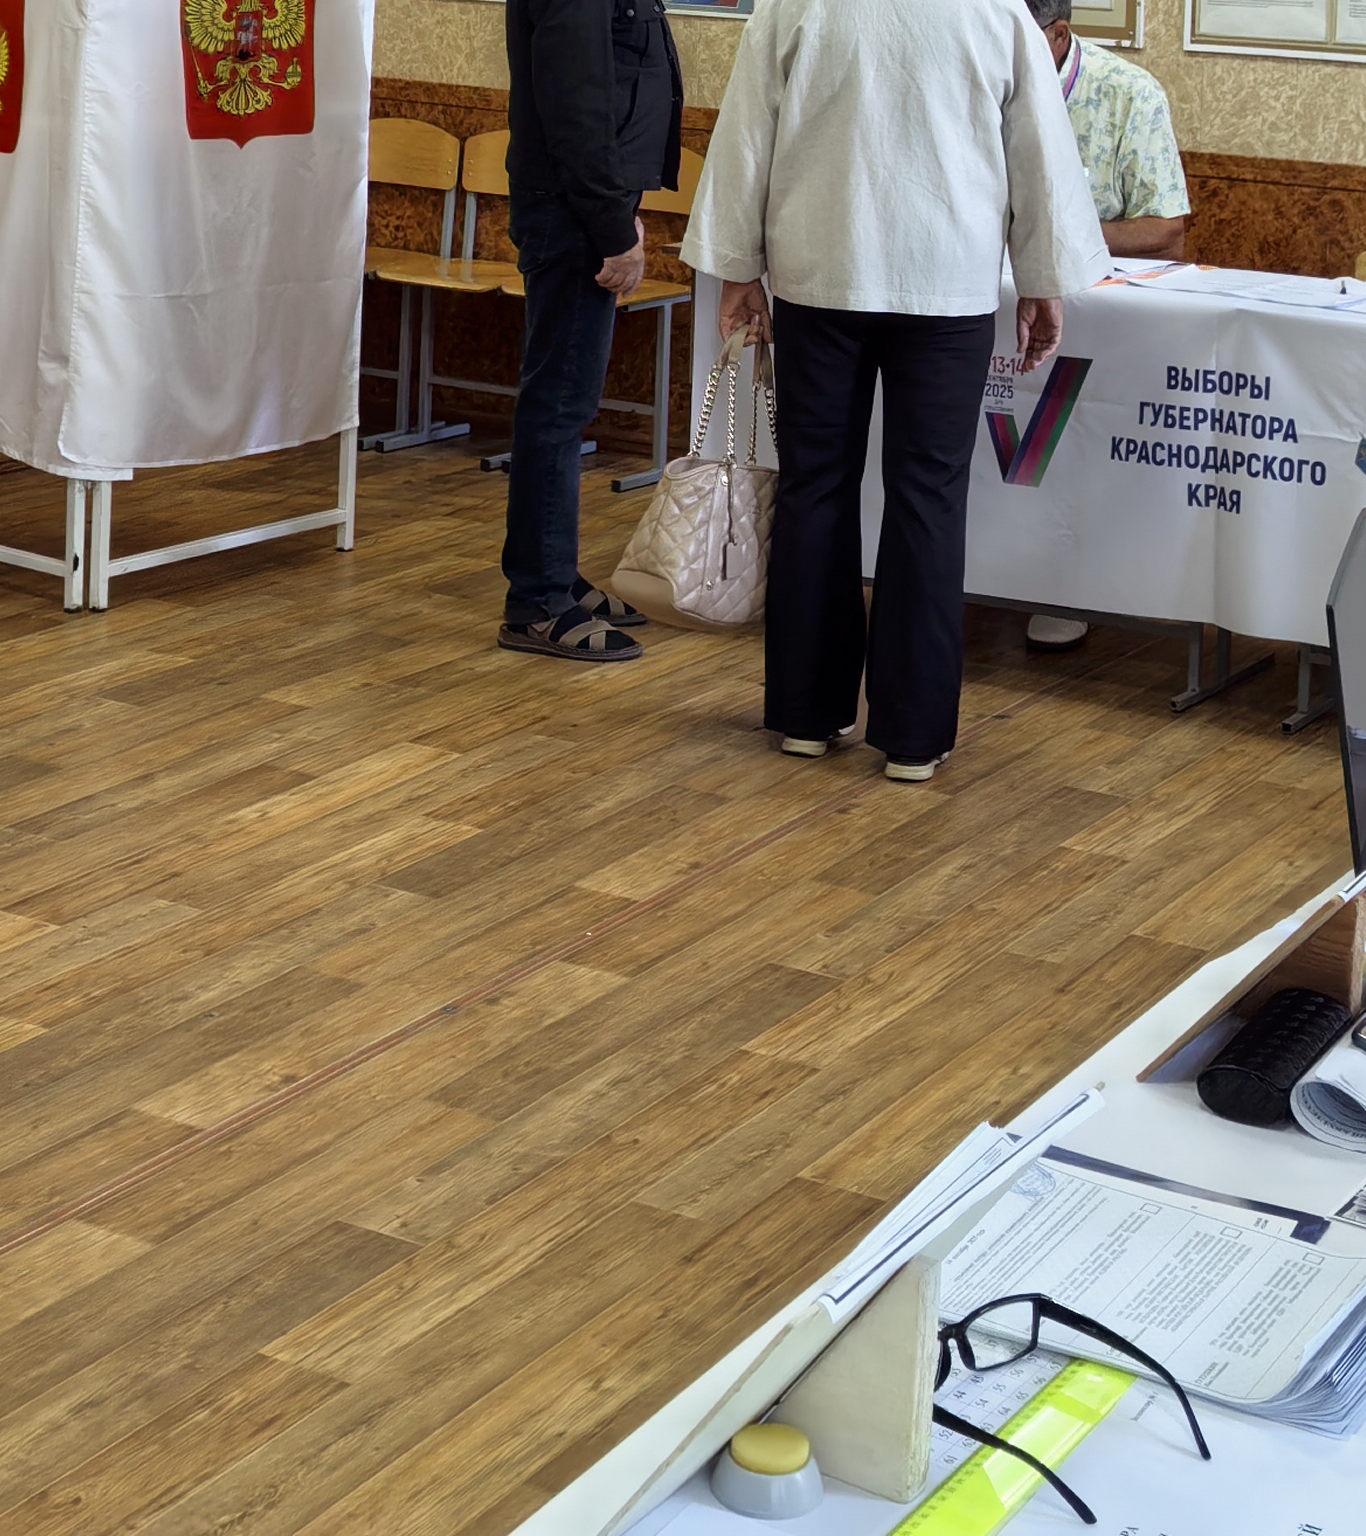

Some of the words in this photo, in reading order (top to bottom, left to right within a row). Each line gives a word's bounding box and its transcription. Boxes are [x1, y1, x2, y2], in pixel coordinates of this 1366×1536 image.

[984, 383, 1014, 400] 2025
[1166, 365, 1272, 401] ВЫБОРЫ
[1138, 401, 1299, 444] ГУБЕРНАТОРА
[1109, 436, 1327, 487] КРАСНОДАРСКОГО
[1187, 483, 1243, 515] КРАЯ
